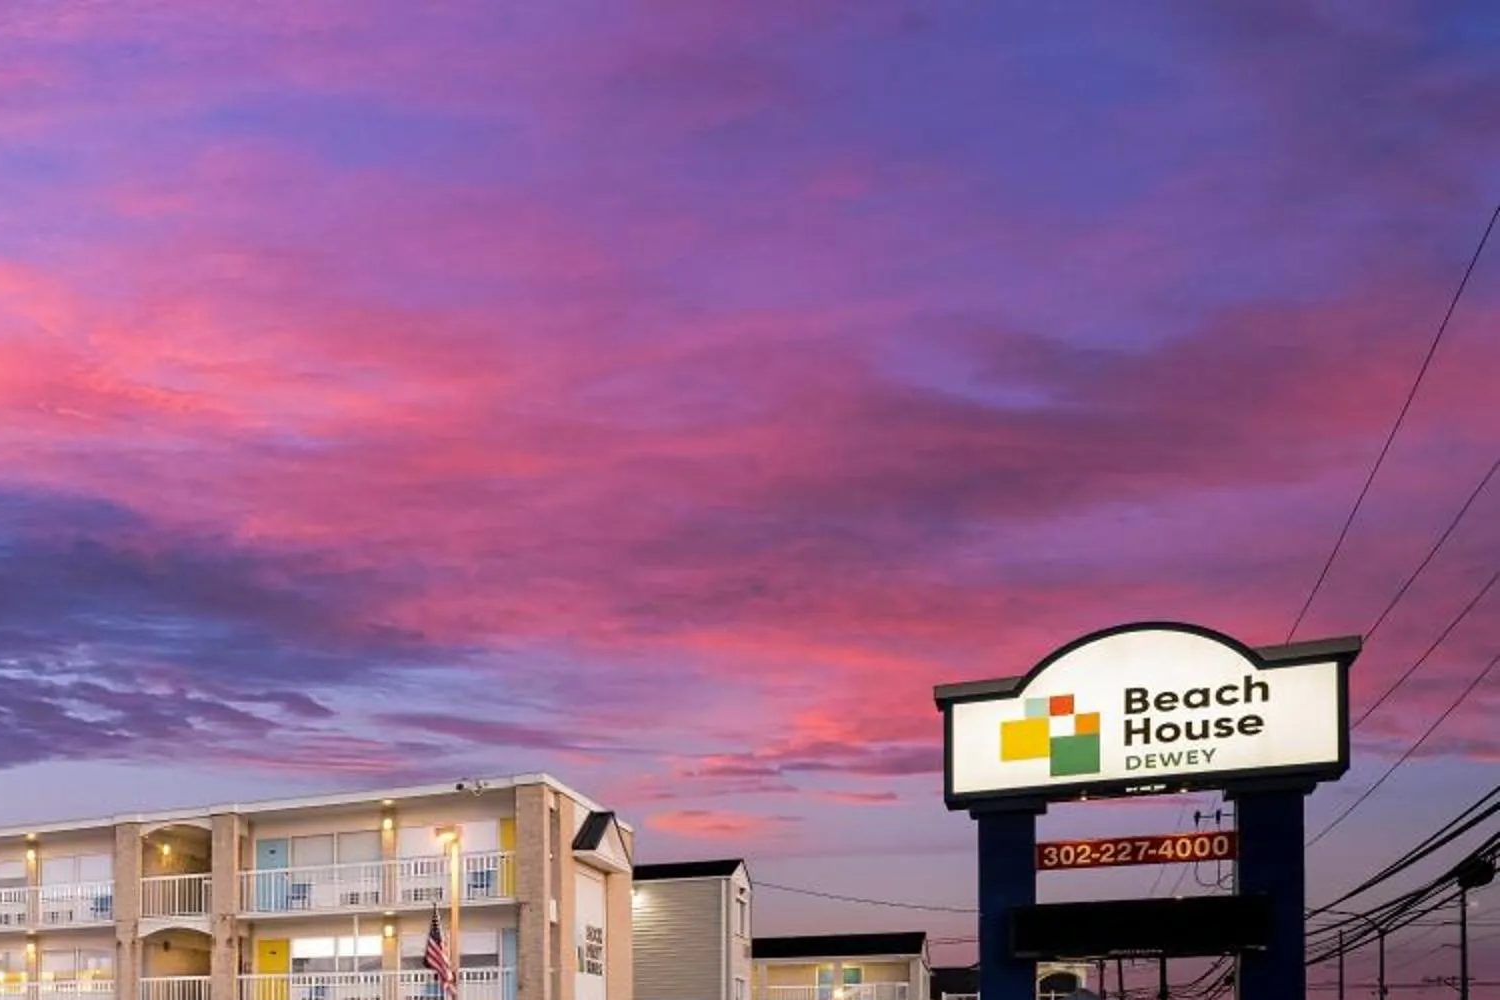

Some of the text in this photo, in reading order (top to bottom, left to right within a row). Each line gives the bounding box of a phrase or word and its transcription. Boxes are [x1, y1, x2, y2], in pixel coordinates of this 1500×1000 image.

[1124, 675, 1269, 714] Beach
[1124, 714, 1264, 746] House
[1125, 748, 1216, 770] DEWEY
[1043, 835, 1229, 866] 302-227-4000
